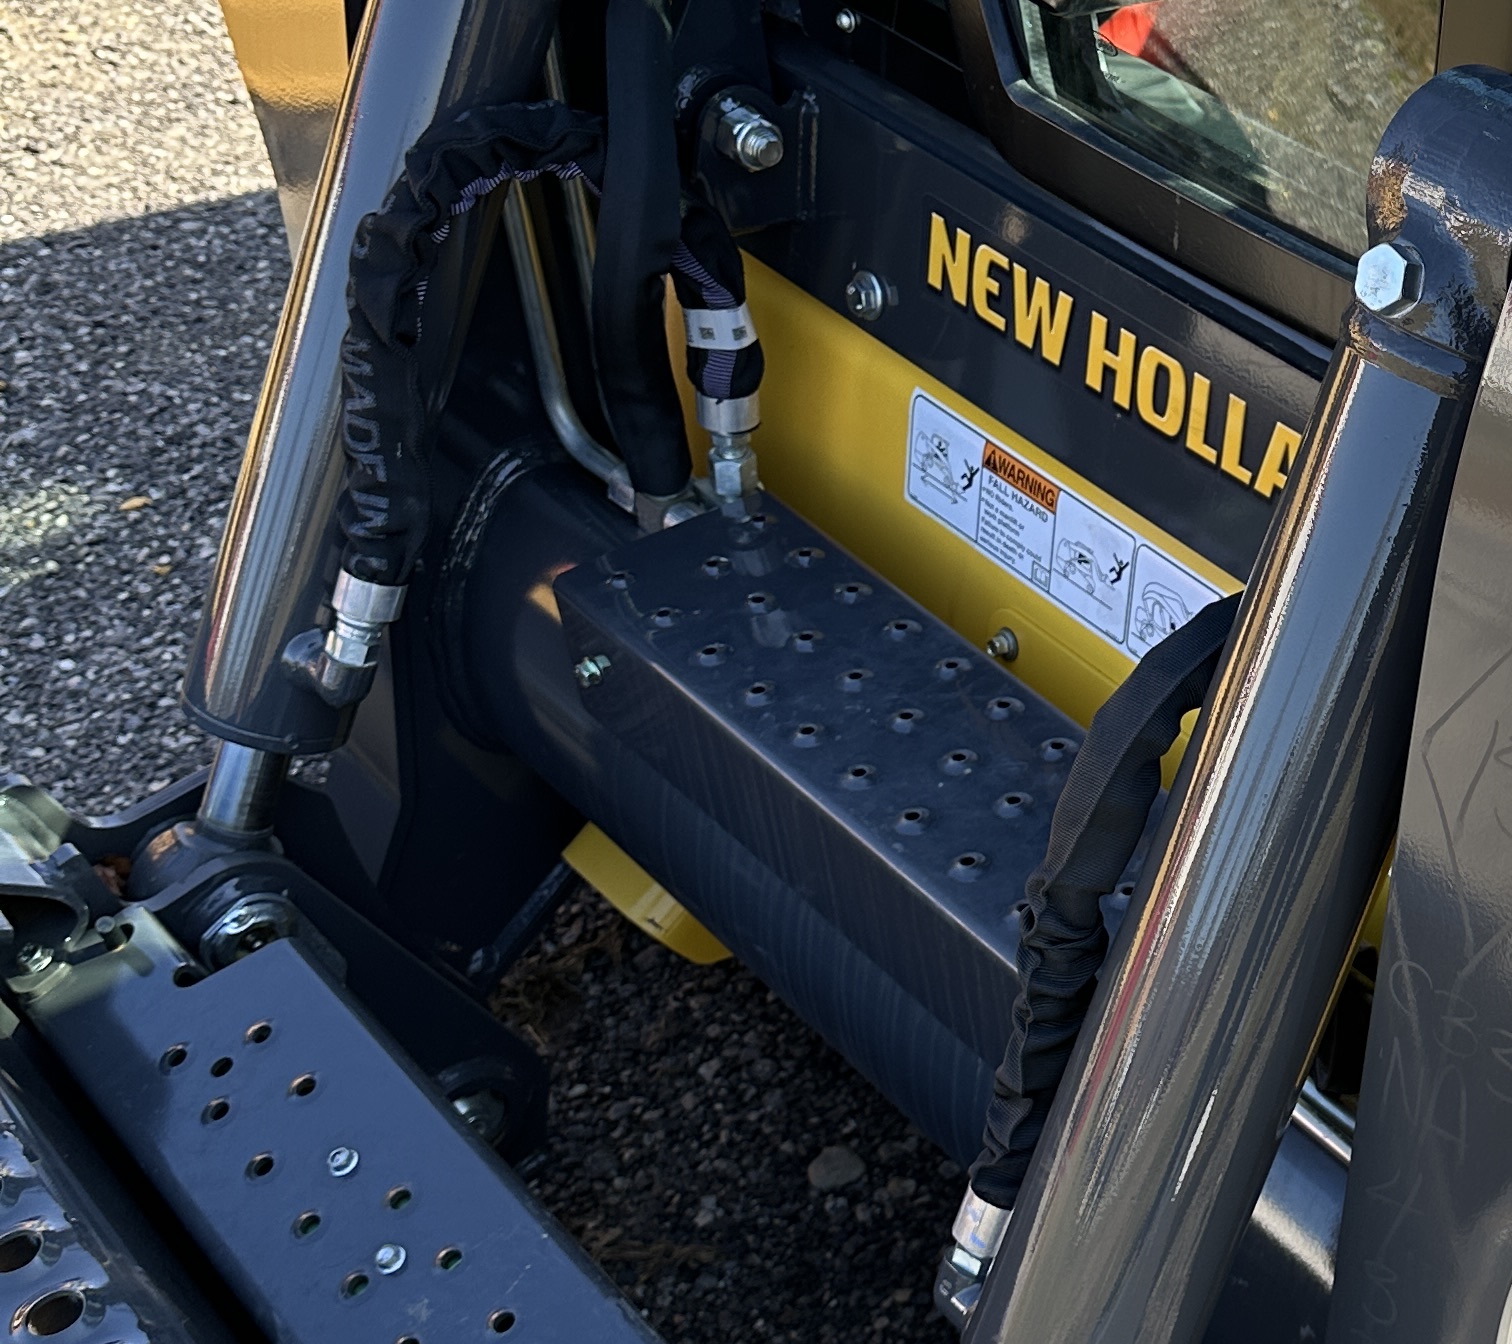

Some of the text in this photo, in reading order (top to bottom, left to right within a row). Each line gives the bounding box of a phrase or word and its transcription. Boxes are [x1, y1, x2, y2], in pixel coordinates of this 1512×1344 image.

[927, 212, 1073, 366] NEW
[341, 337, 388, 483] MADE
[988, 474, 1049, 523] FALL HAZARD
[998, 456, 1055, 508] WARNING
[348, 489, 390, 539] IN
